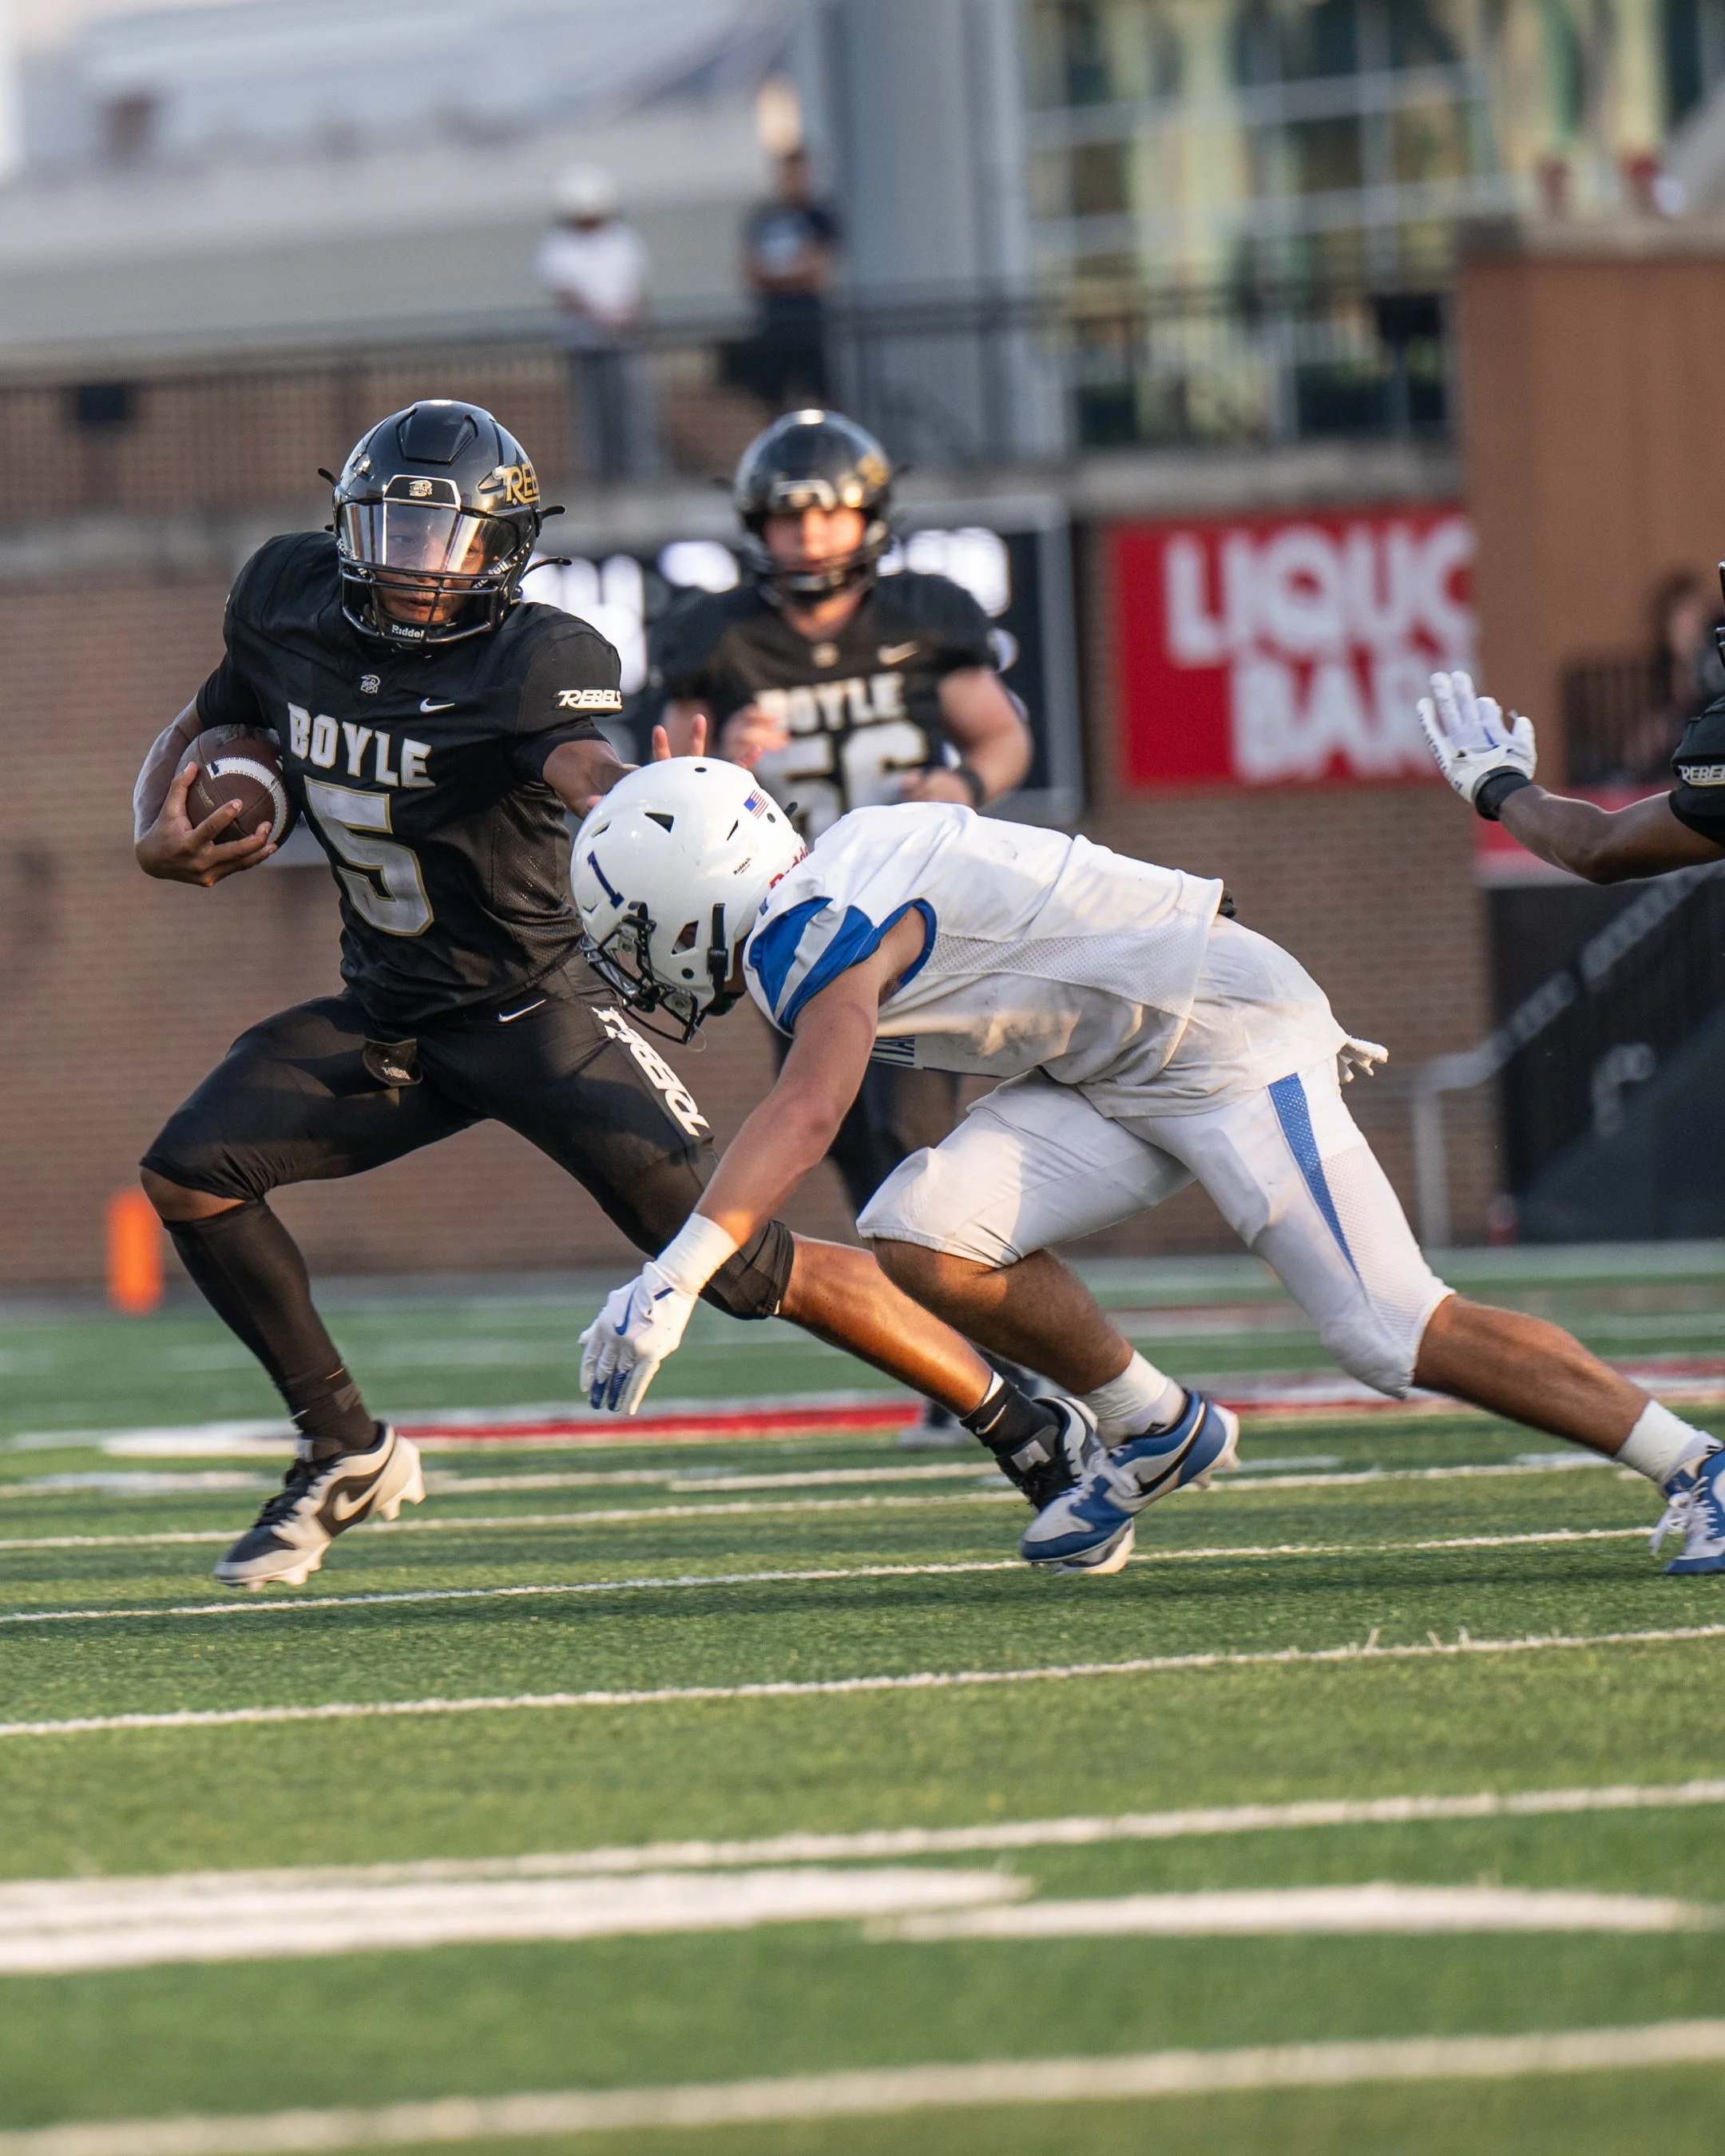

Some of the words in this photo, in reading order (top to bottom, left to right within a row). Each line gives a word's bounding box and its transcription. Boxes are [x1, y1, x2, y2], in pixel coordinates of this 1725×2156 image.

[392, 624, 425, 638] Riddel
[288, 702, 436, 788] BOYLE
[1235, 650, 1477, 781] BAR
[303, 775, 434, 937] 5
